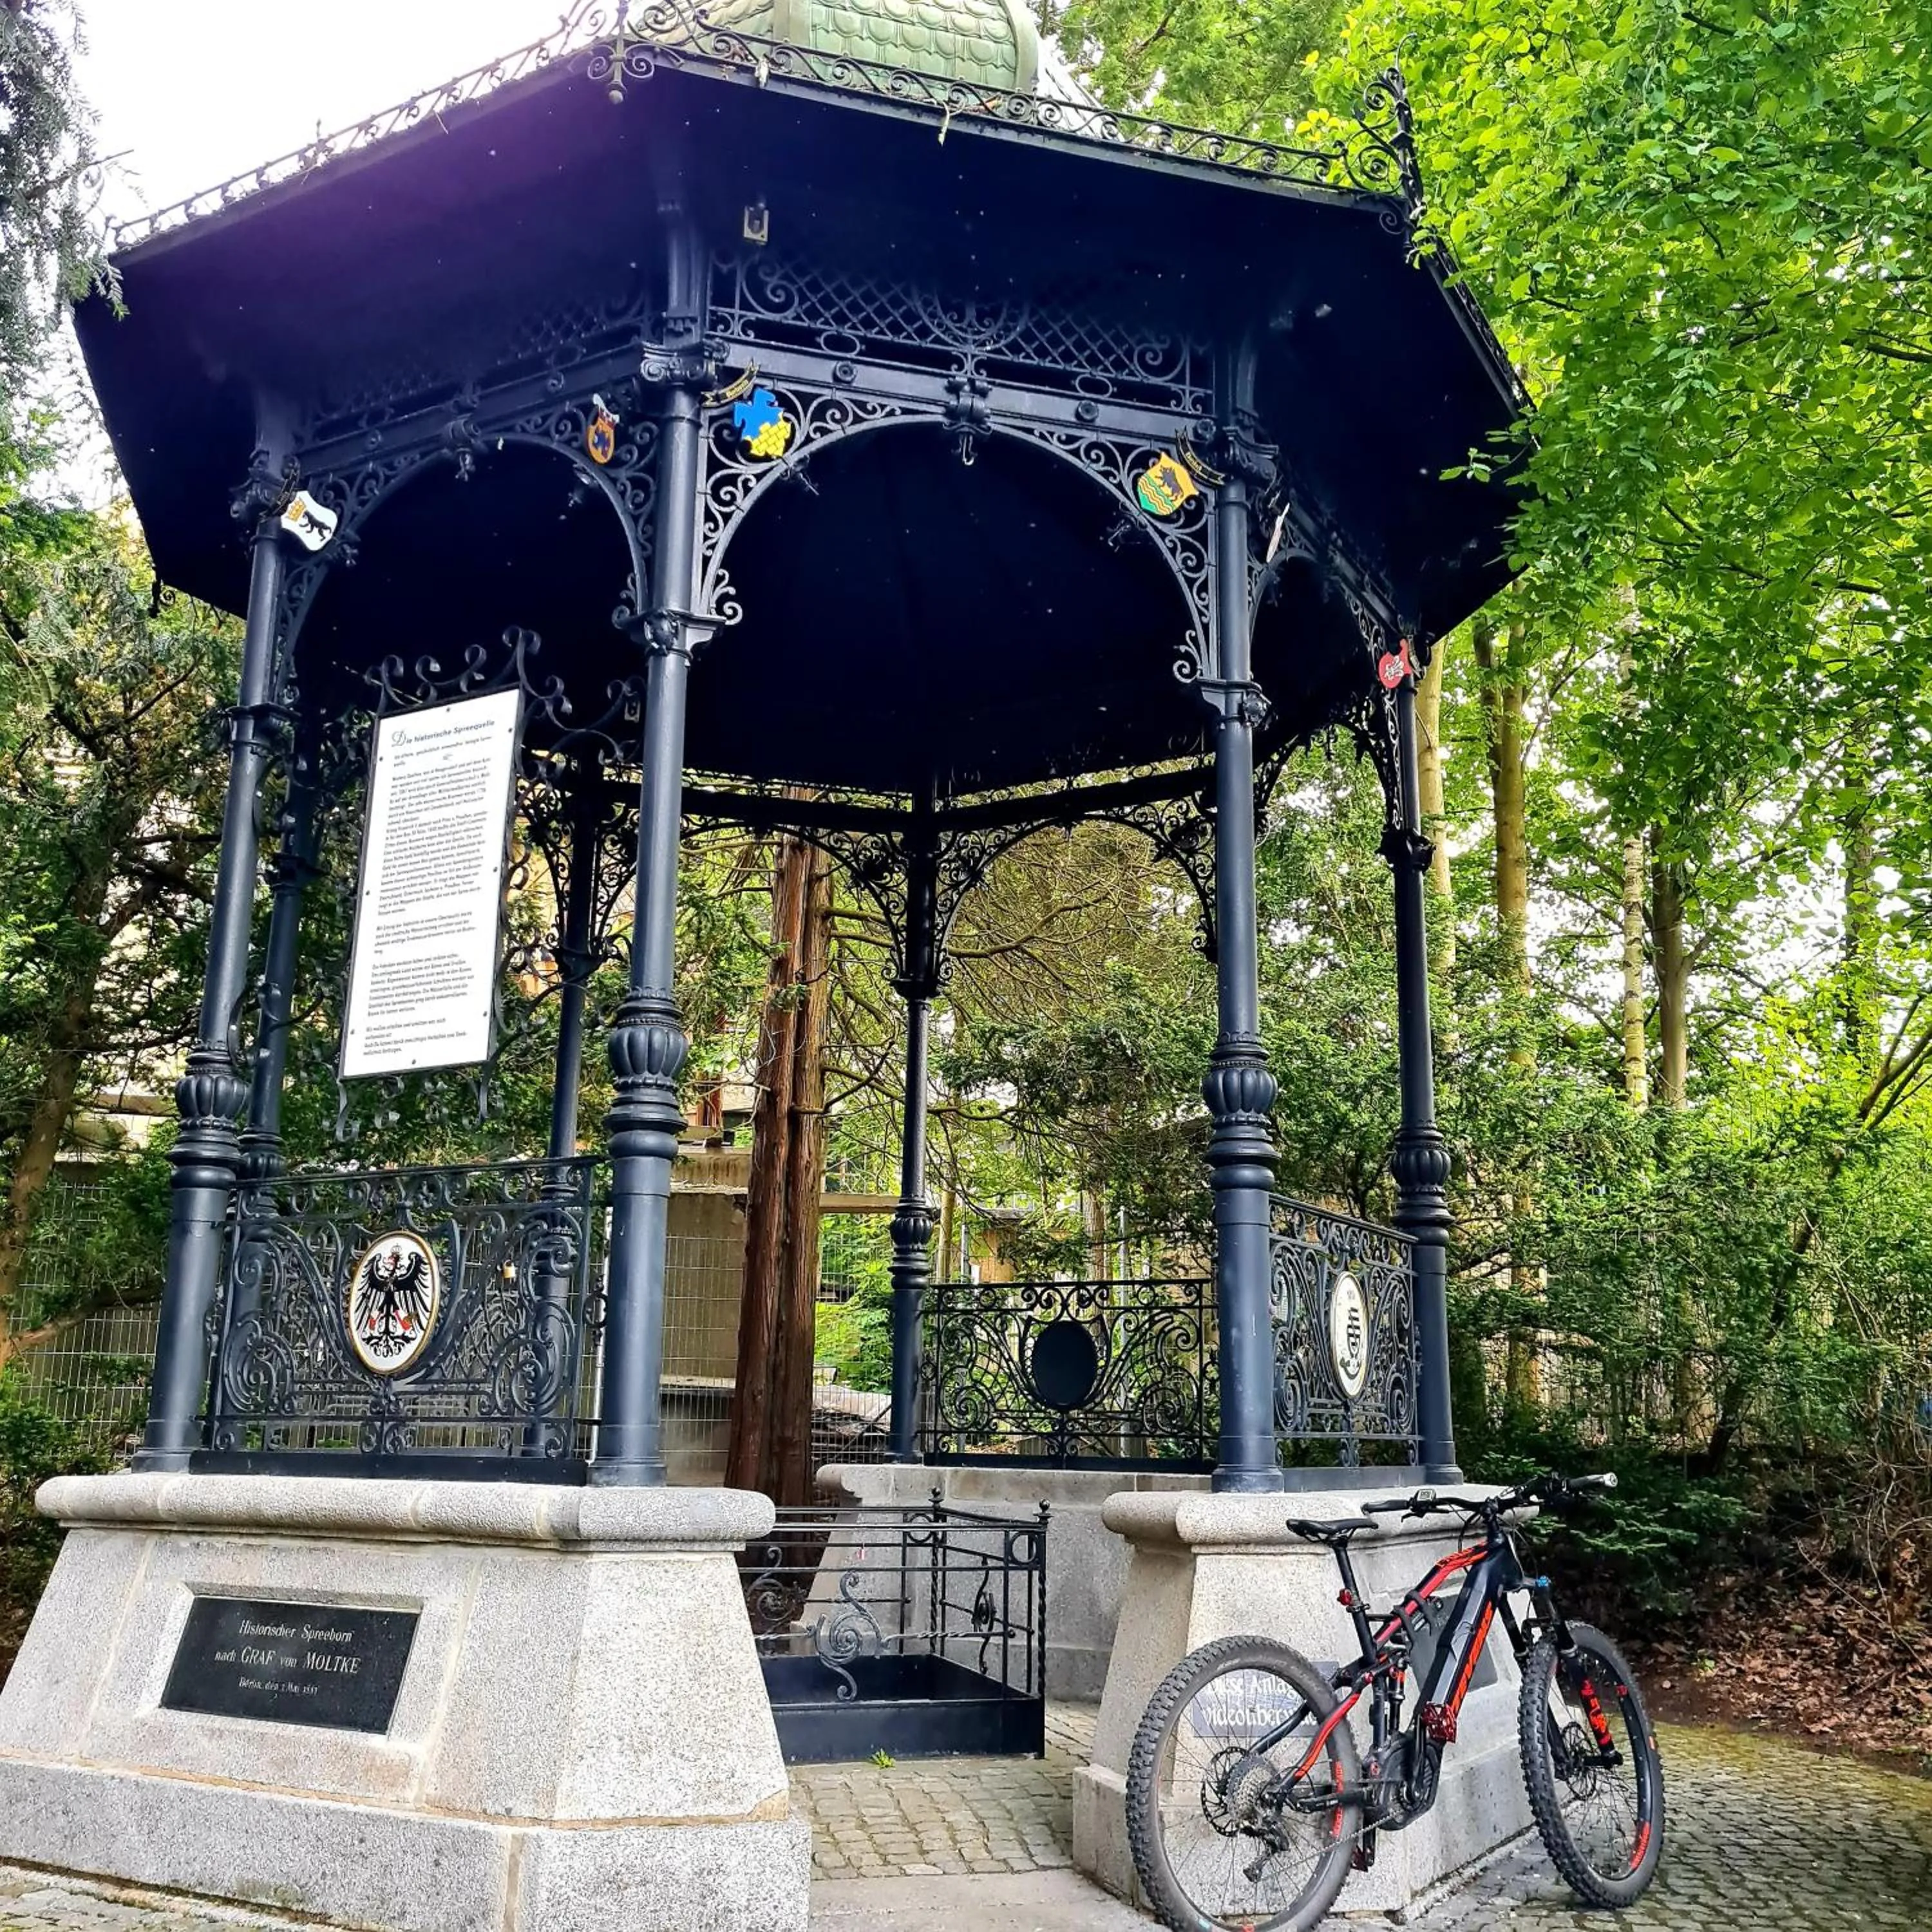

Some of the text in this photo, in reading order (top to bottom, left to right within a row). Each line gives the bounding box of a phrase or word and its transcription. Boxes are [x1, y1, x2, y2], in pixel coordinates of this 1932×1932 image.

[392, 720, 495, 748] Die historische Spreequelle
[239, 1620, 352, 1642] Historischer Spreeborn
[214, 1645, 361, 1674] nach GRAF von MOLTKE
